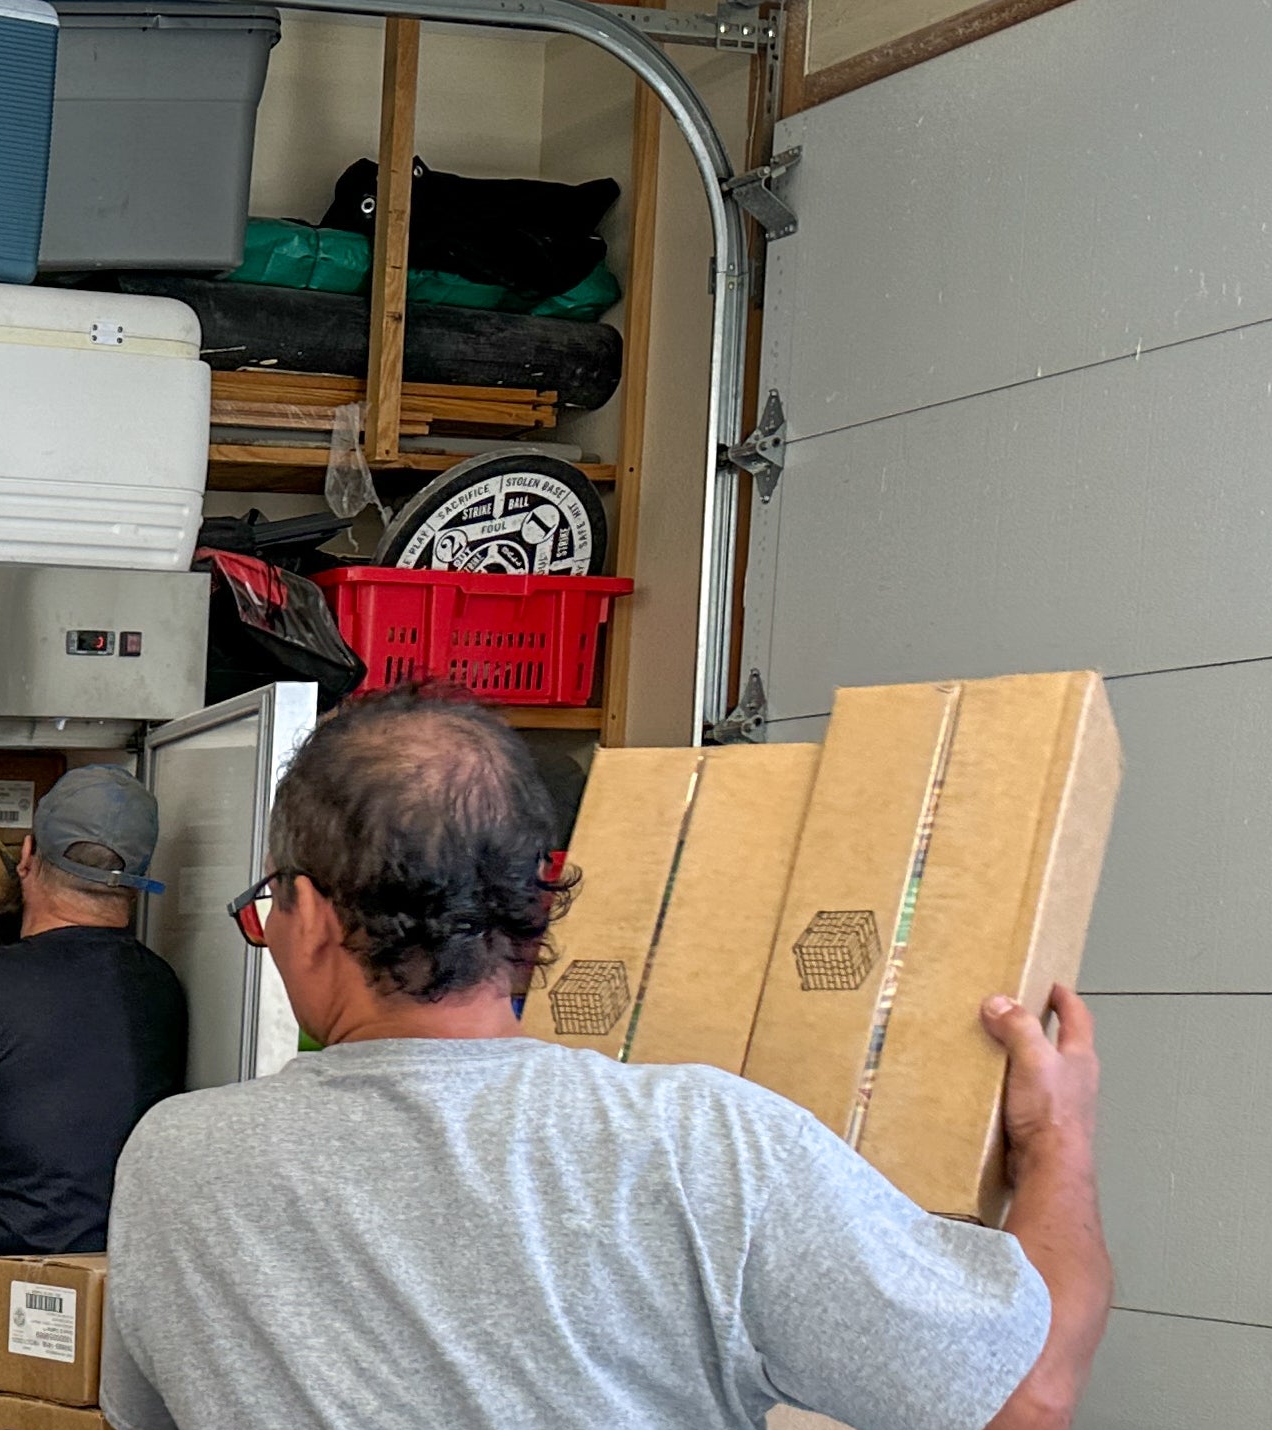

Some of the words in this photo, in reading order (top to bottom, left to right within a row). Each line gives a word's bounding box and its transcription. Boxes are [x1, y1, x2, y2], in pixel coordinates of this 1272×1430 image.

[505, 476, 541, 488] STOLEN
[541, 480, 567, 500] BASE
[437, 484, 491, 521] SACRIFICE
[461, 502, 493, 521] STRIKE
[507, 495, 529, 510] BALL
[567, 502, 583, 520] HIT
[481, 522, 507, 534] FOUL
[575, 518, 589, 550] SAFE
[411, 531, 429, 555] PLAY
[441, 535, 463, 560] 2
[557, 526, 569, 558] STRIKE
